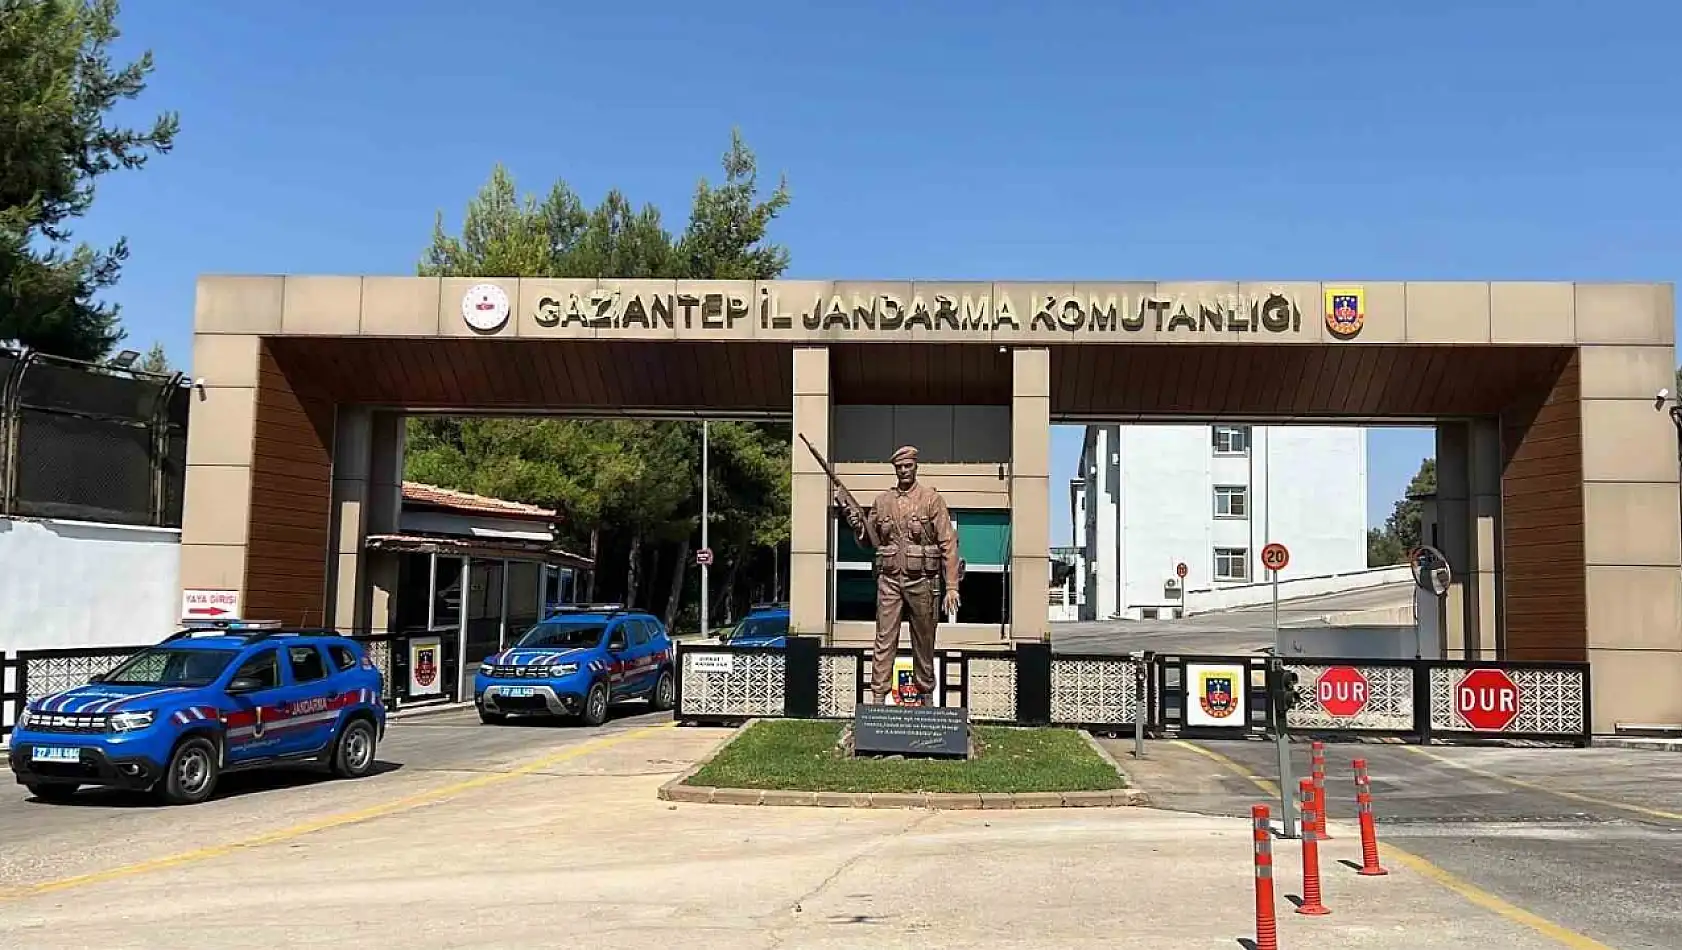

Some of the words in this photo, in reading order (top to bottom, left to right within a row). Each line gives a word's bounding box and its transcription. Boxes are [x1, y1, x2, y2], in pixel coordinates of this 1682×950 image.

[534, 287, 750, 329] GAZİANTEP
[759, 288, 793, 329] İL
[801, 292, 1021, 331] JANDARMA
[1030, 292, 1302, 333] KOMUTANLIĞI
[1267, 549, 1284, 563] 20
[186, 594, 207, 603] YAYA
[1321, 681, 1365, 701] DUR
[1461, 688, 1515, 712] DUR
